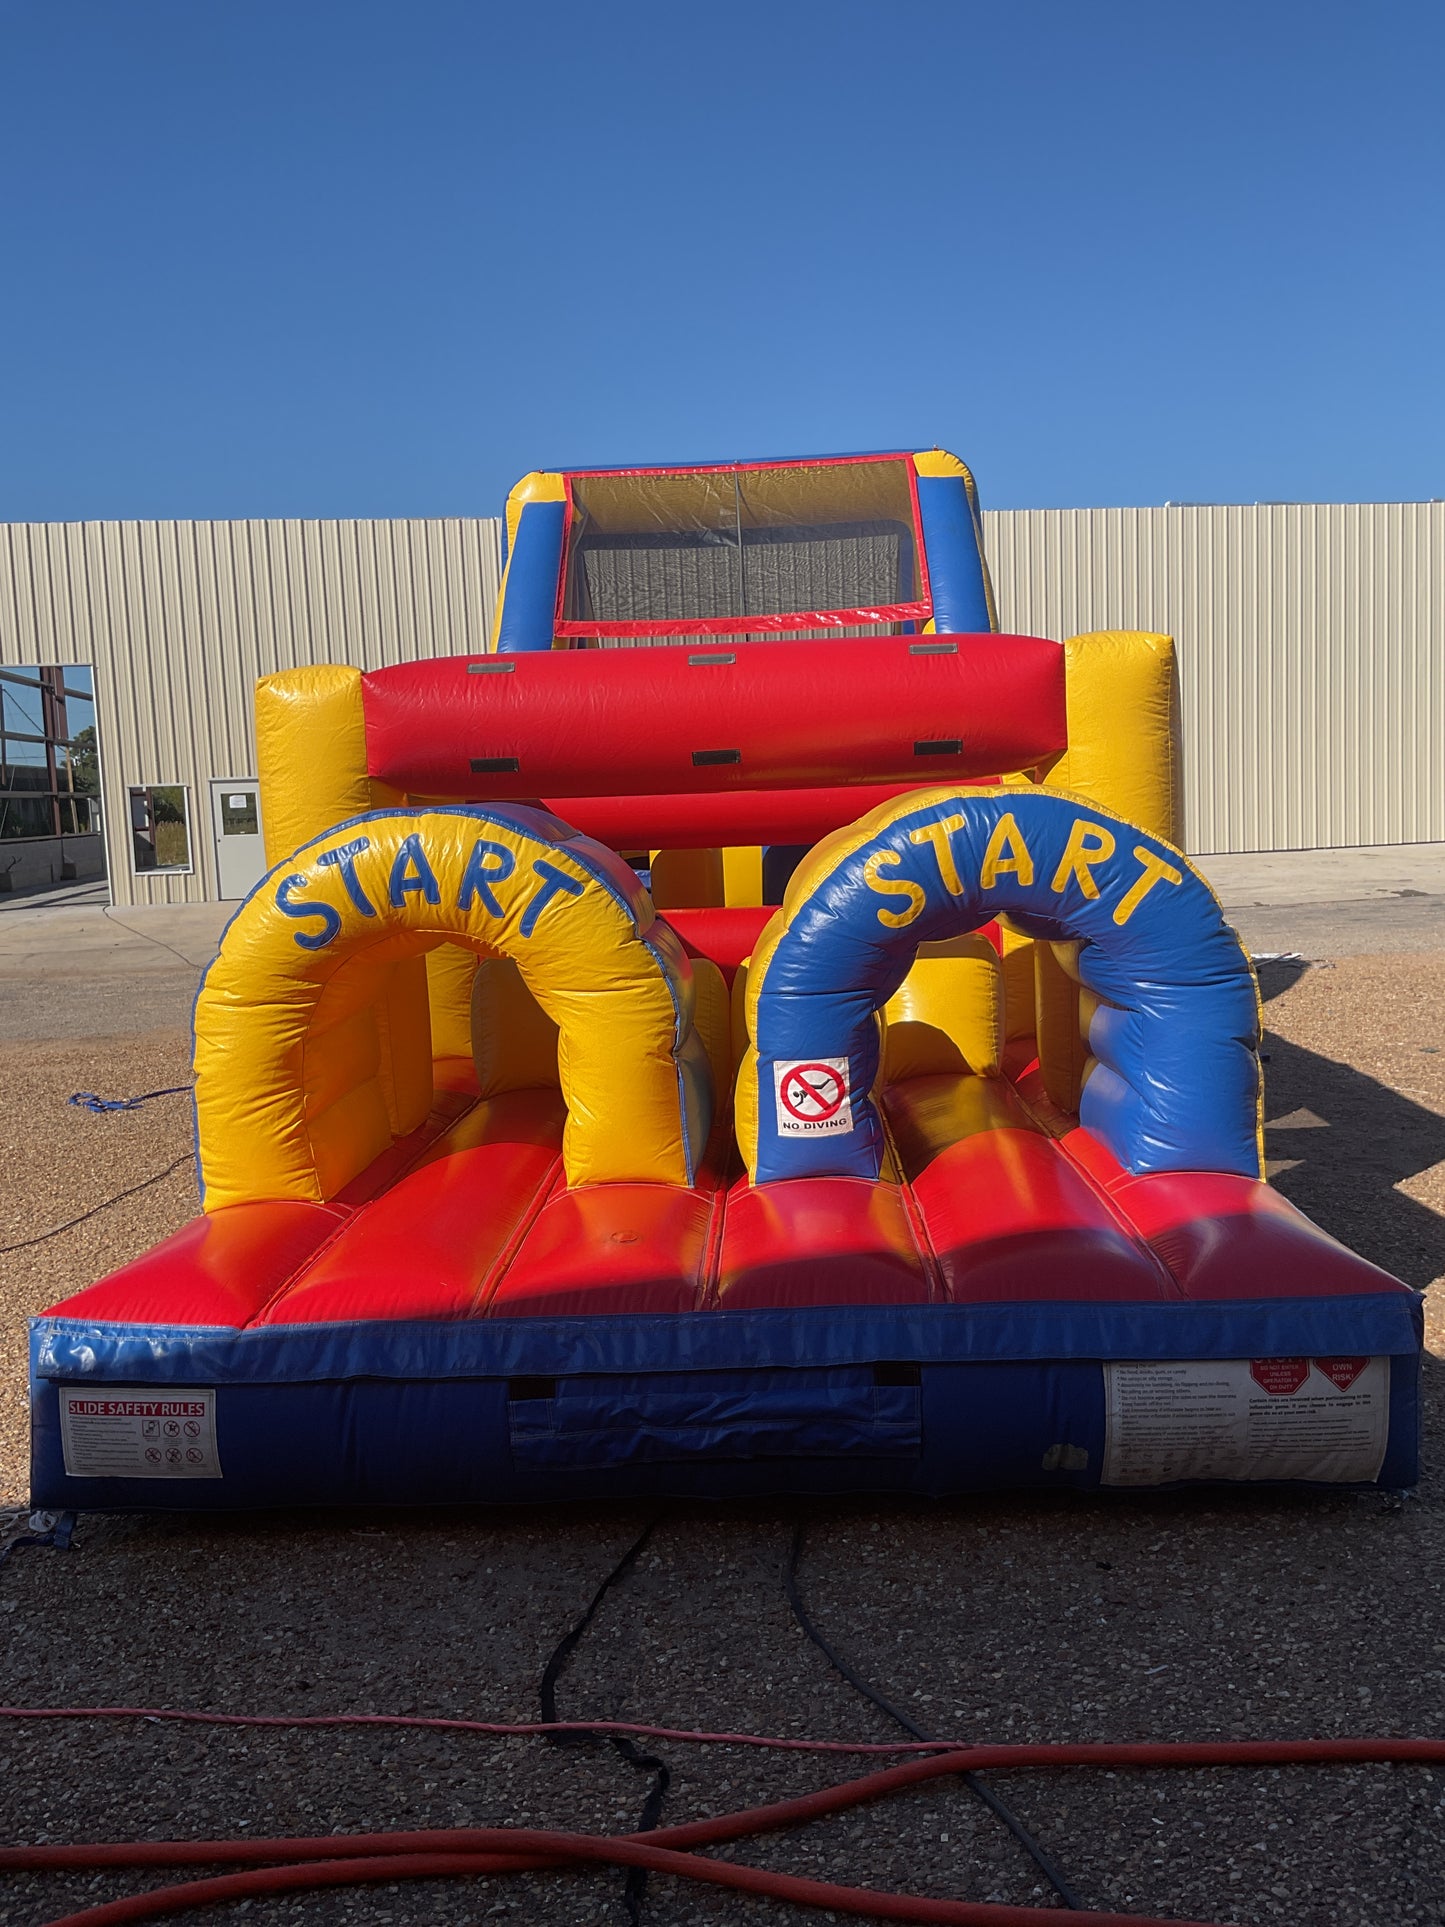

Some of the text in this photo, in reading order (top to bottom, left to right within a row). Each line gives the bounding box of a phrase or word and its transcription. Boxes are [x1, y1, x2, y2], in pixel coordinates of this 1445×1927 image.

[864, 812, 1183, 929] START
[274, 832, 585, 951] START
[783, 1118, 847, 1130] NO DIVING
[1332, 1363, 1353, 1371] OWN
[1332, 1373, 1354, 1381] RISK!
[69, 1402, 204, 1416] SLIDE SAFETY RULES
